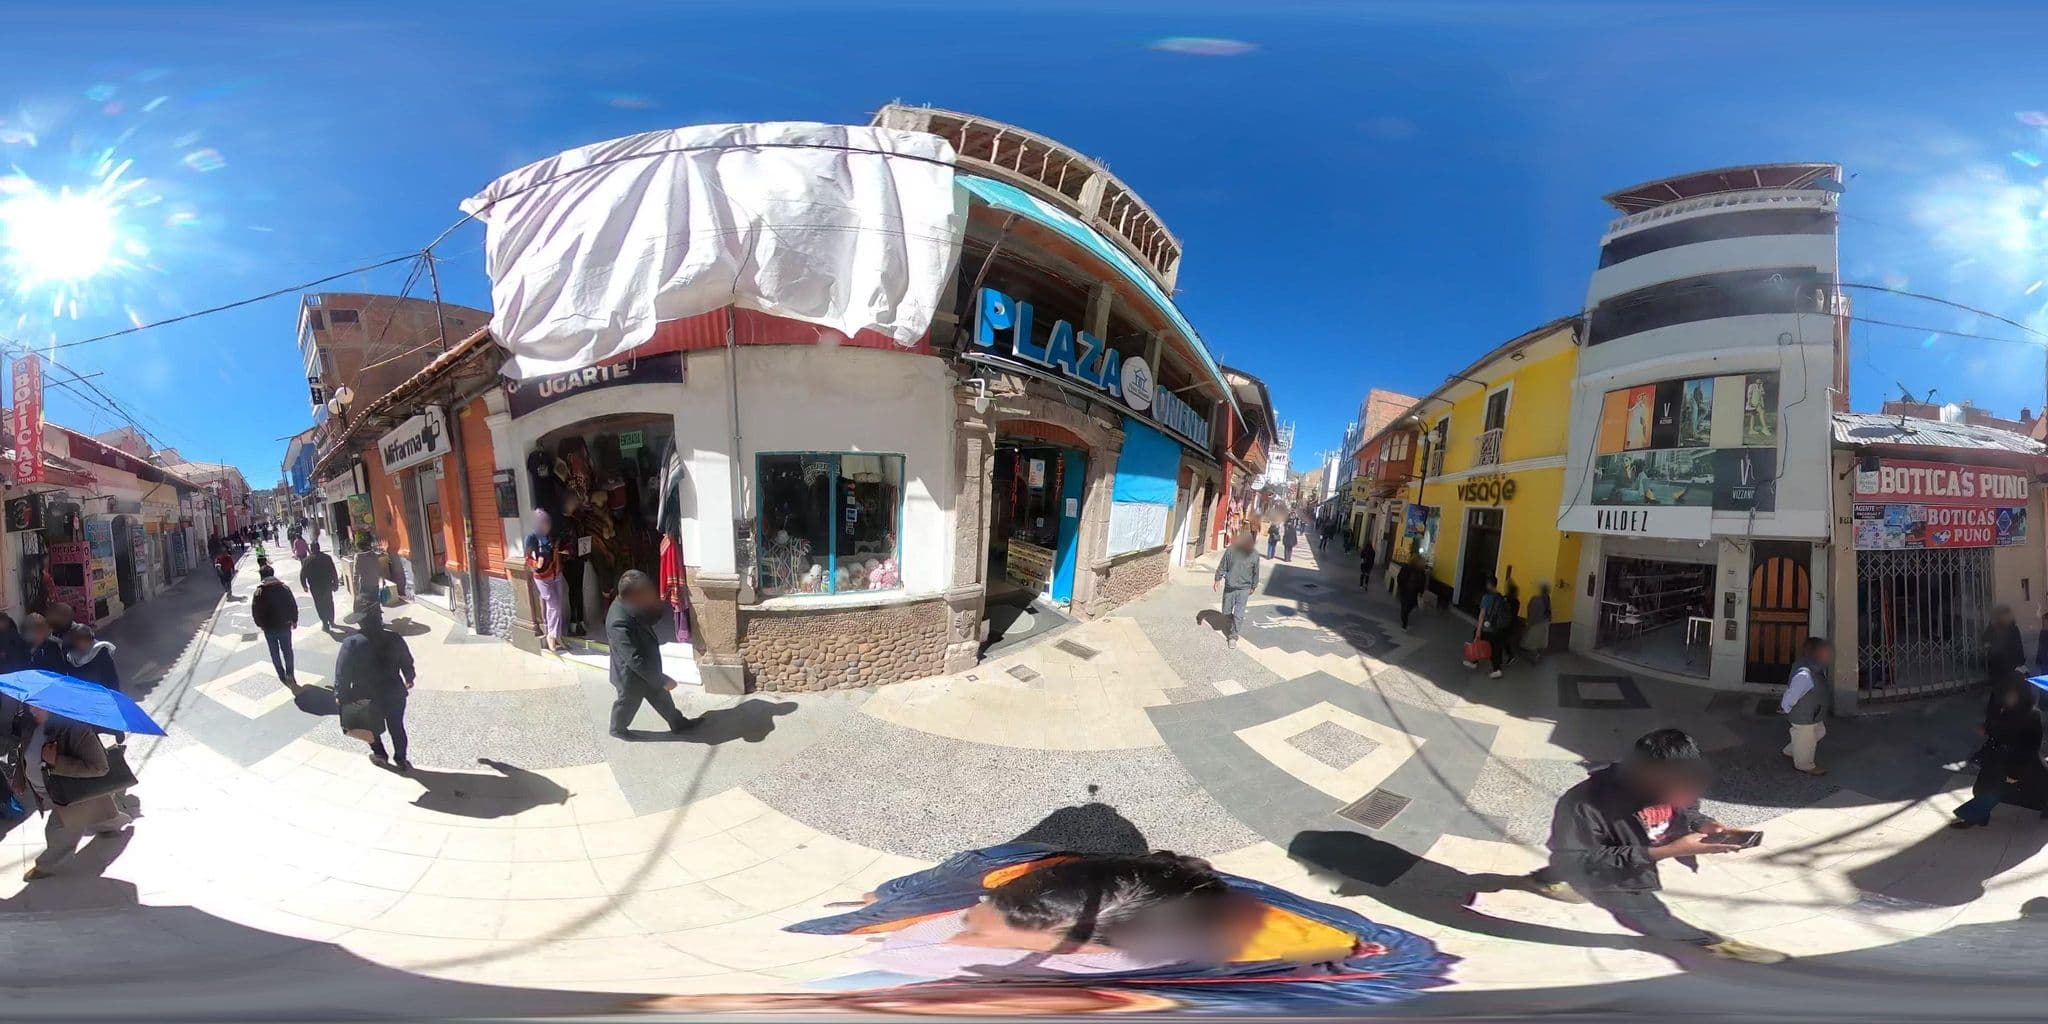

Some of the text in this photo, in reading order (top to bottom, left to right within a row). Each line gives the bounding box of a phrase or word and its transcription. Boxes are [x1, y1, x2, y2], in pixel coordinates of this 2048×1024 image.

[974, 287, 1122, 398] PLAZA
[538, 362, 631, 398] UGARTE
[15, 373, 34, 478] BOTICAS
[384, 434, 422, 466] Mifarma
[1980, 473, 2029, 499] PUNO
[1597, 510, 1649, 532] VALDEZ
[1953, 527, 1991, 543] PUNO
